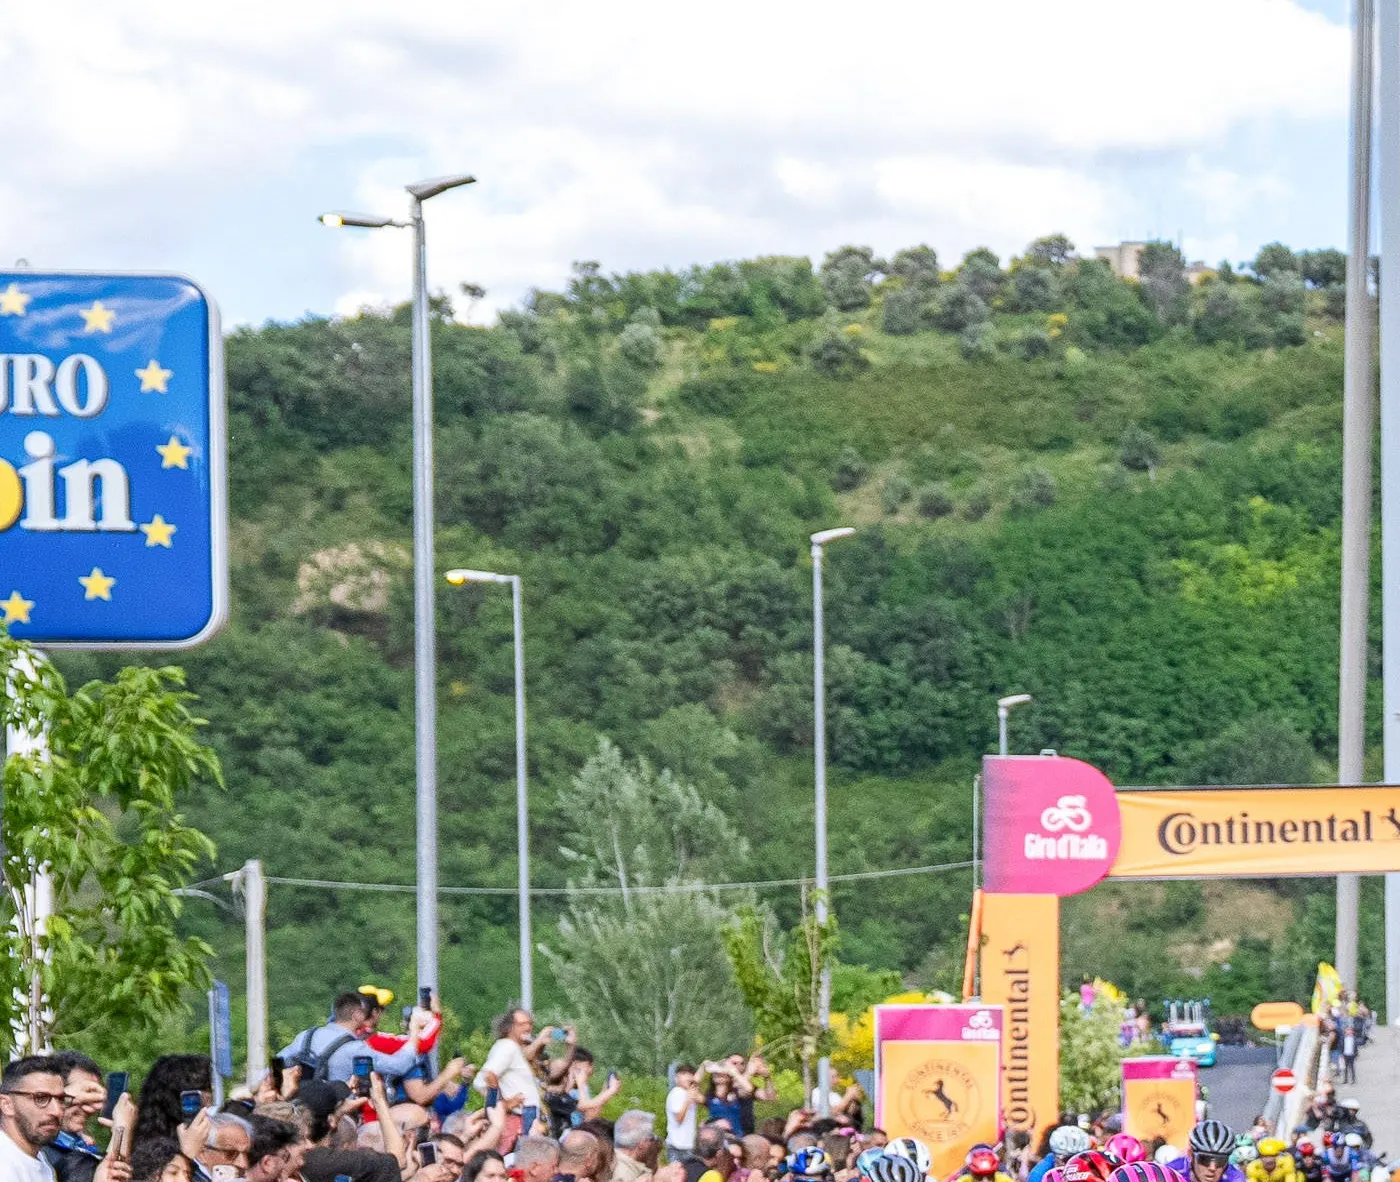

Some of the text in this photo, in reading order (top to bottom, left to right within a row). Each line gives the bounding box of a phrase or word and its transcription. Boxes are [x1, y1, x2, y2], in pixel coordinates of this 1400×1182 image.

[0, 353, 109, 417] RO
[0, 431, 138, 532] in
[1158, 811, 1373, 855] Continental
